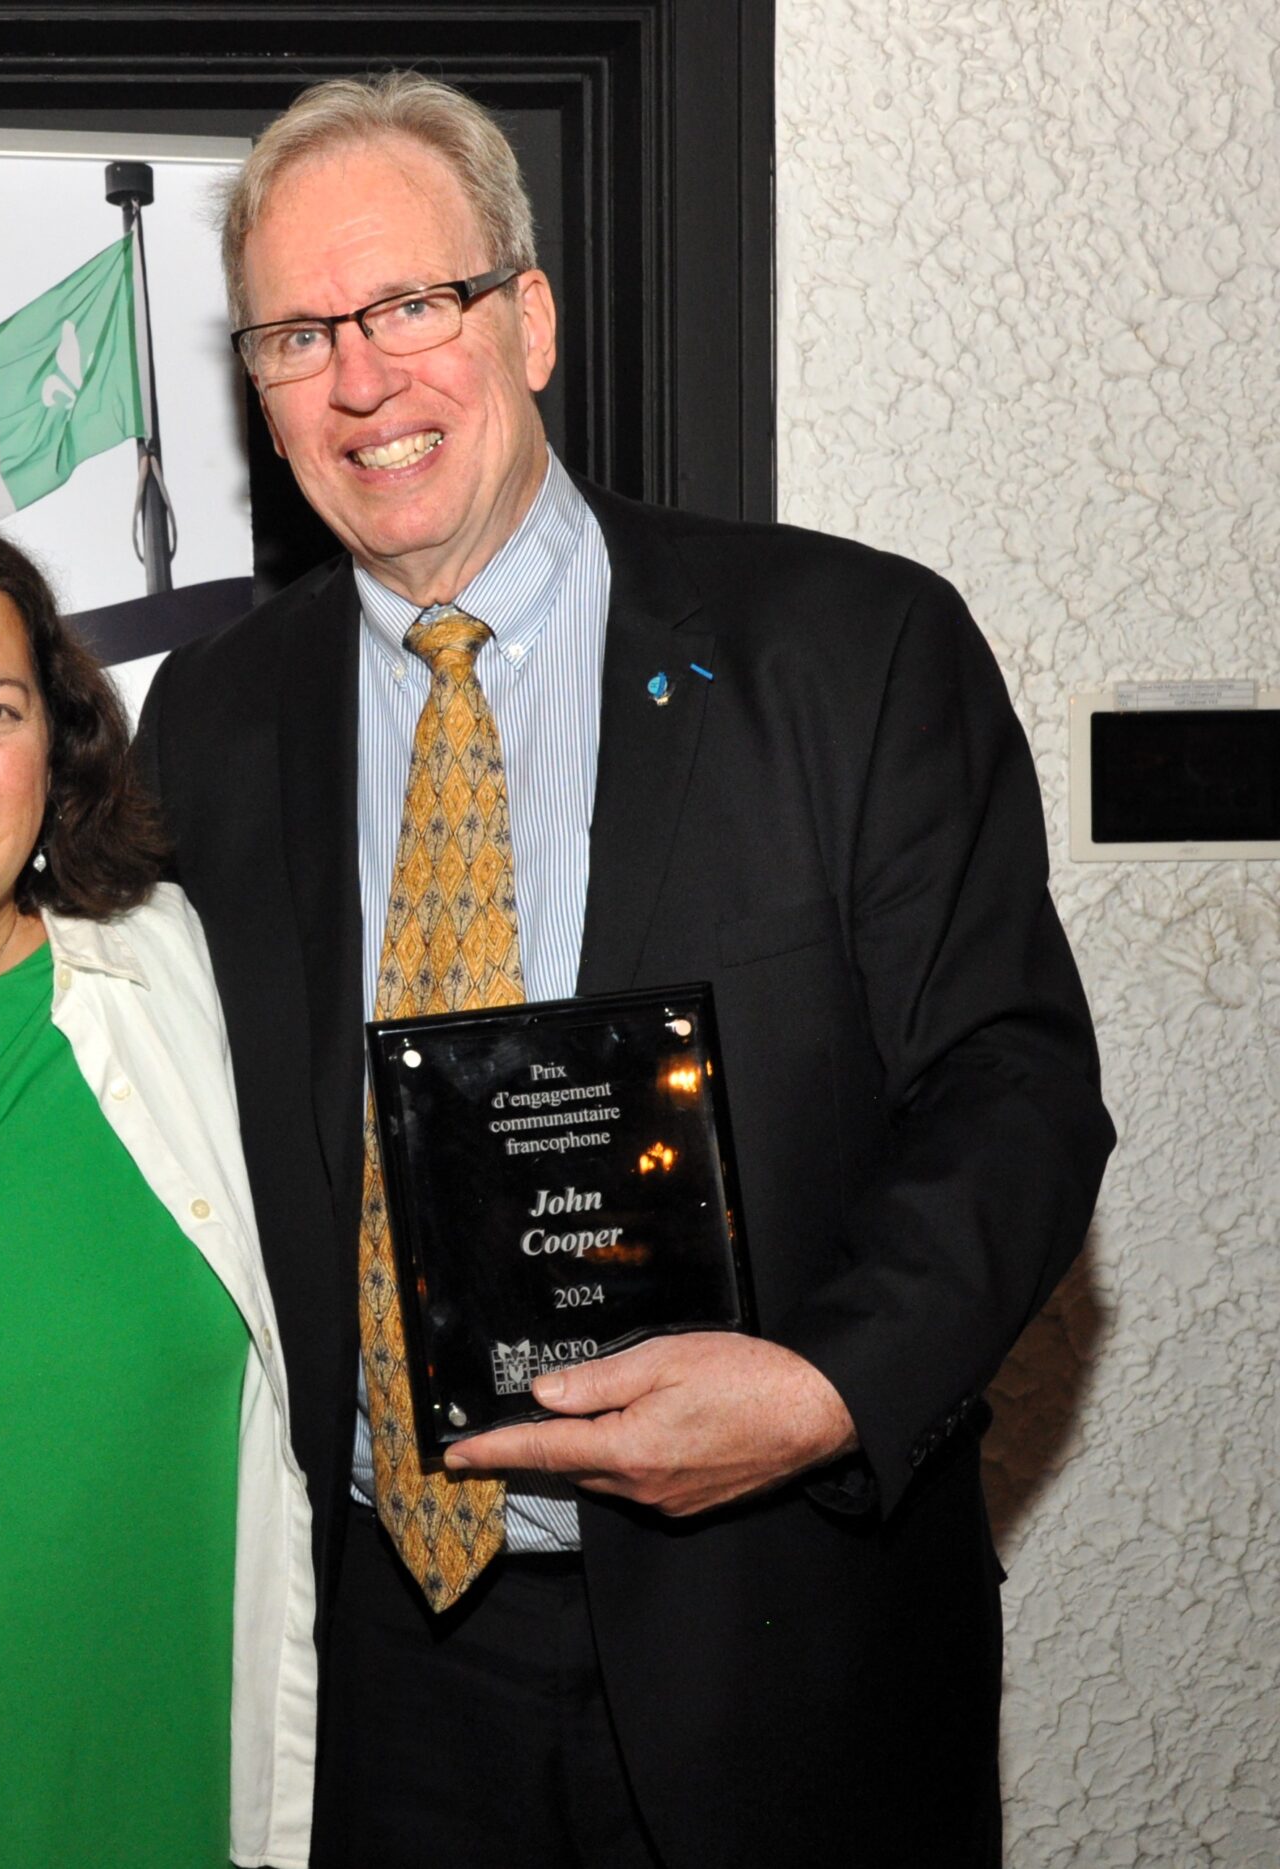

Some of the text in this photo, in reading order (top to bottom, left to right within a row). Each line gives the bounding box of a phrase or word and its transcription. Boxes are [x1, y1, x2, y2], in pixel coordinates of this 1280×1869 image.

[531, 1064, 566, 1081] Prix
[493, 1083, 611, 1108] d'engagement
[489, 1105, 620, 1133] communautaire
[506, 1131, 610, 1156] francophone
[530, 1187, 602, 1217] John
[521, 1227, 623, 1257] Cooper
[554, 1285, 604, 1309] 2024
[541, 1339, 598, 1362] ACFO
